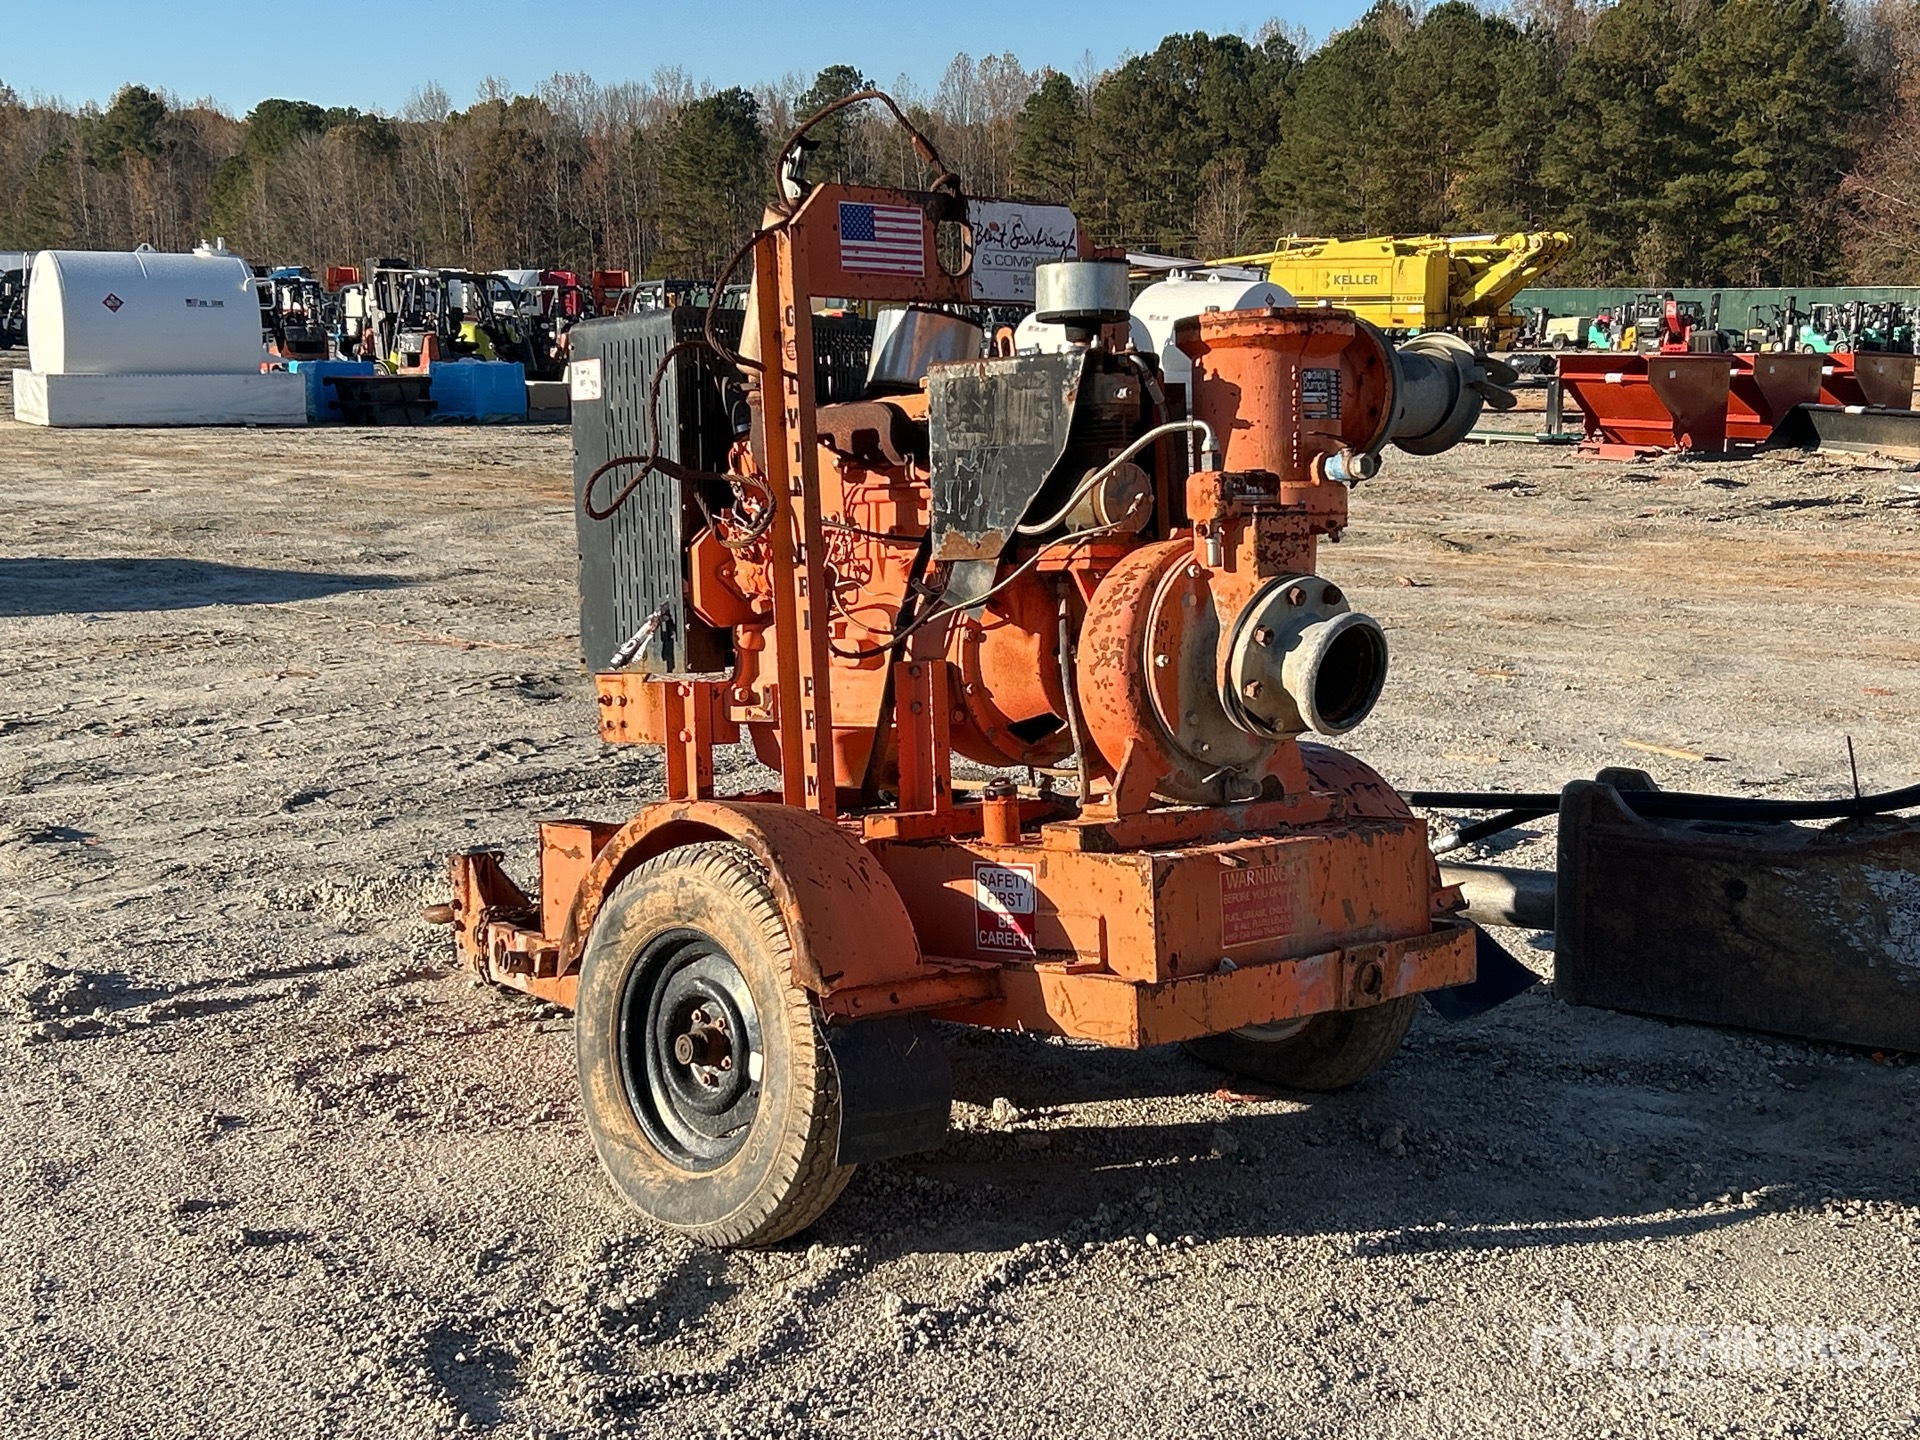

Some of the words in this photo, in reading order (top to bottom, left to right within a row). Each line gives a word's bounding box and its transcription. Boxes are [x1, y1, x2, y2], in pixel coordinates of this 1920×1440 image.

[982, 253, 992, 265] &
[995, 254, 1048, 268] COMPA
[1333, 274, 1378, 286] KELLER
[803, 676, 819, 811] PRIM
[979, 872, 1029, 889] SAFETY
[1226, 866, 1288, 889] WARNING
[987, 891, 1024, 907] FIRST
[980, 930, 1033, 948] CAREFU
